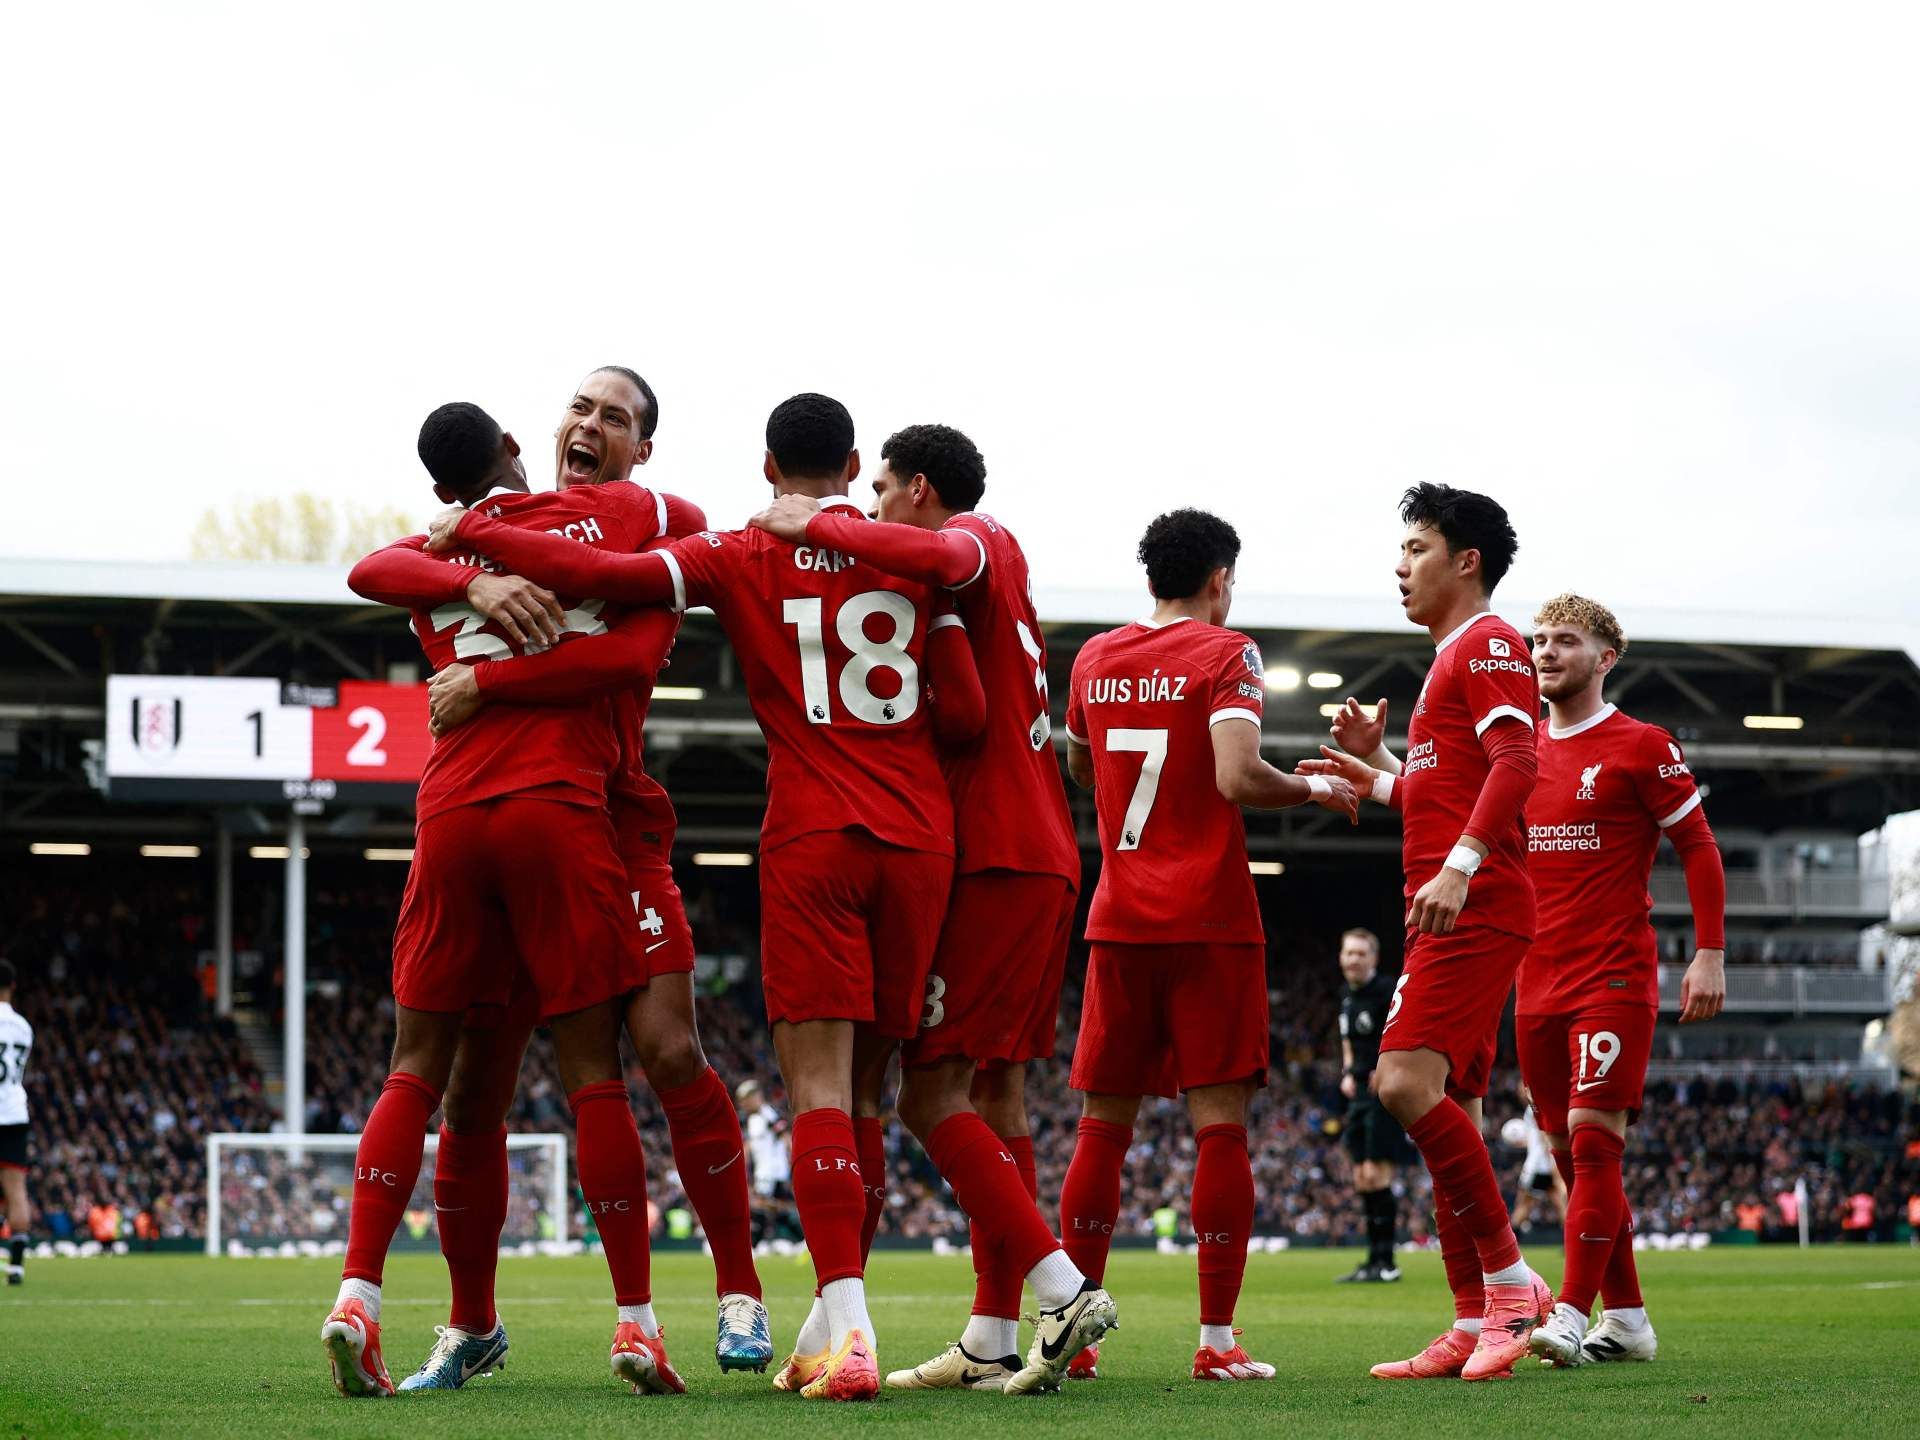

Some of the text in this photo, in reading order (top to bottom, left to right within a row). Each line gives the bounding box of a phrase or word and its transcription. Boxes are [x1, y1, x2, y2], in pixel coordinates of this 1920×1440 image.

[794, 546, 855, 573] GAK
[783, 590, 919, 724] 18
[1469, 658, 1531, 677] Expedia
[1087, 668, 1187, 704] LUIS DÍAZ
[246, 710, 262, 758] 1
[346, 706, 387, 766] 2
[1106, 728, 1169, 850] 7
[1528, 822, 1595, 838] standard
[1528, 836, 1600, 852] chartered
[1579, 1031, 1620, 1078] 19
[357, 1167, 397, 1186] LFC
[814, 1158, 860, 1176] LFC
[587, 1200, 630, 1214] LFC
[1073, 1217, 1112, 1234] LFC
[1195, 1232, 1230, 1244] LFC
